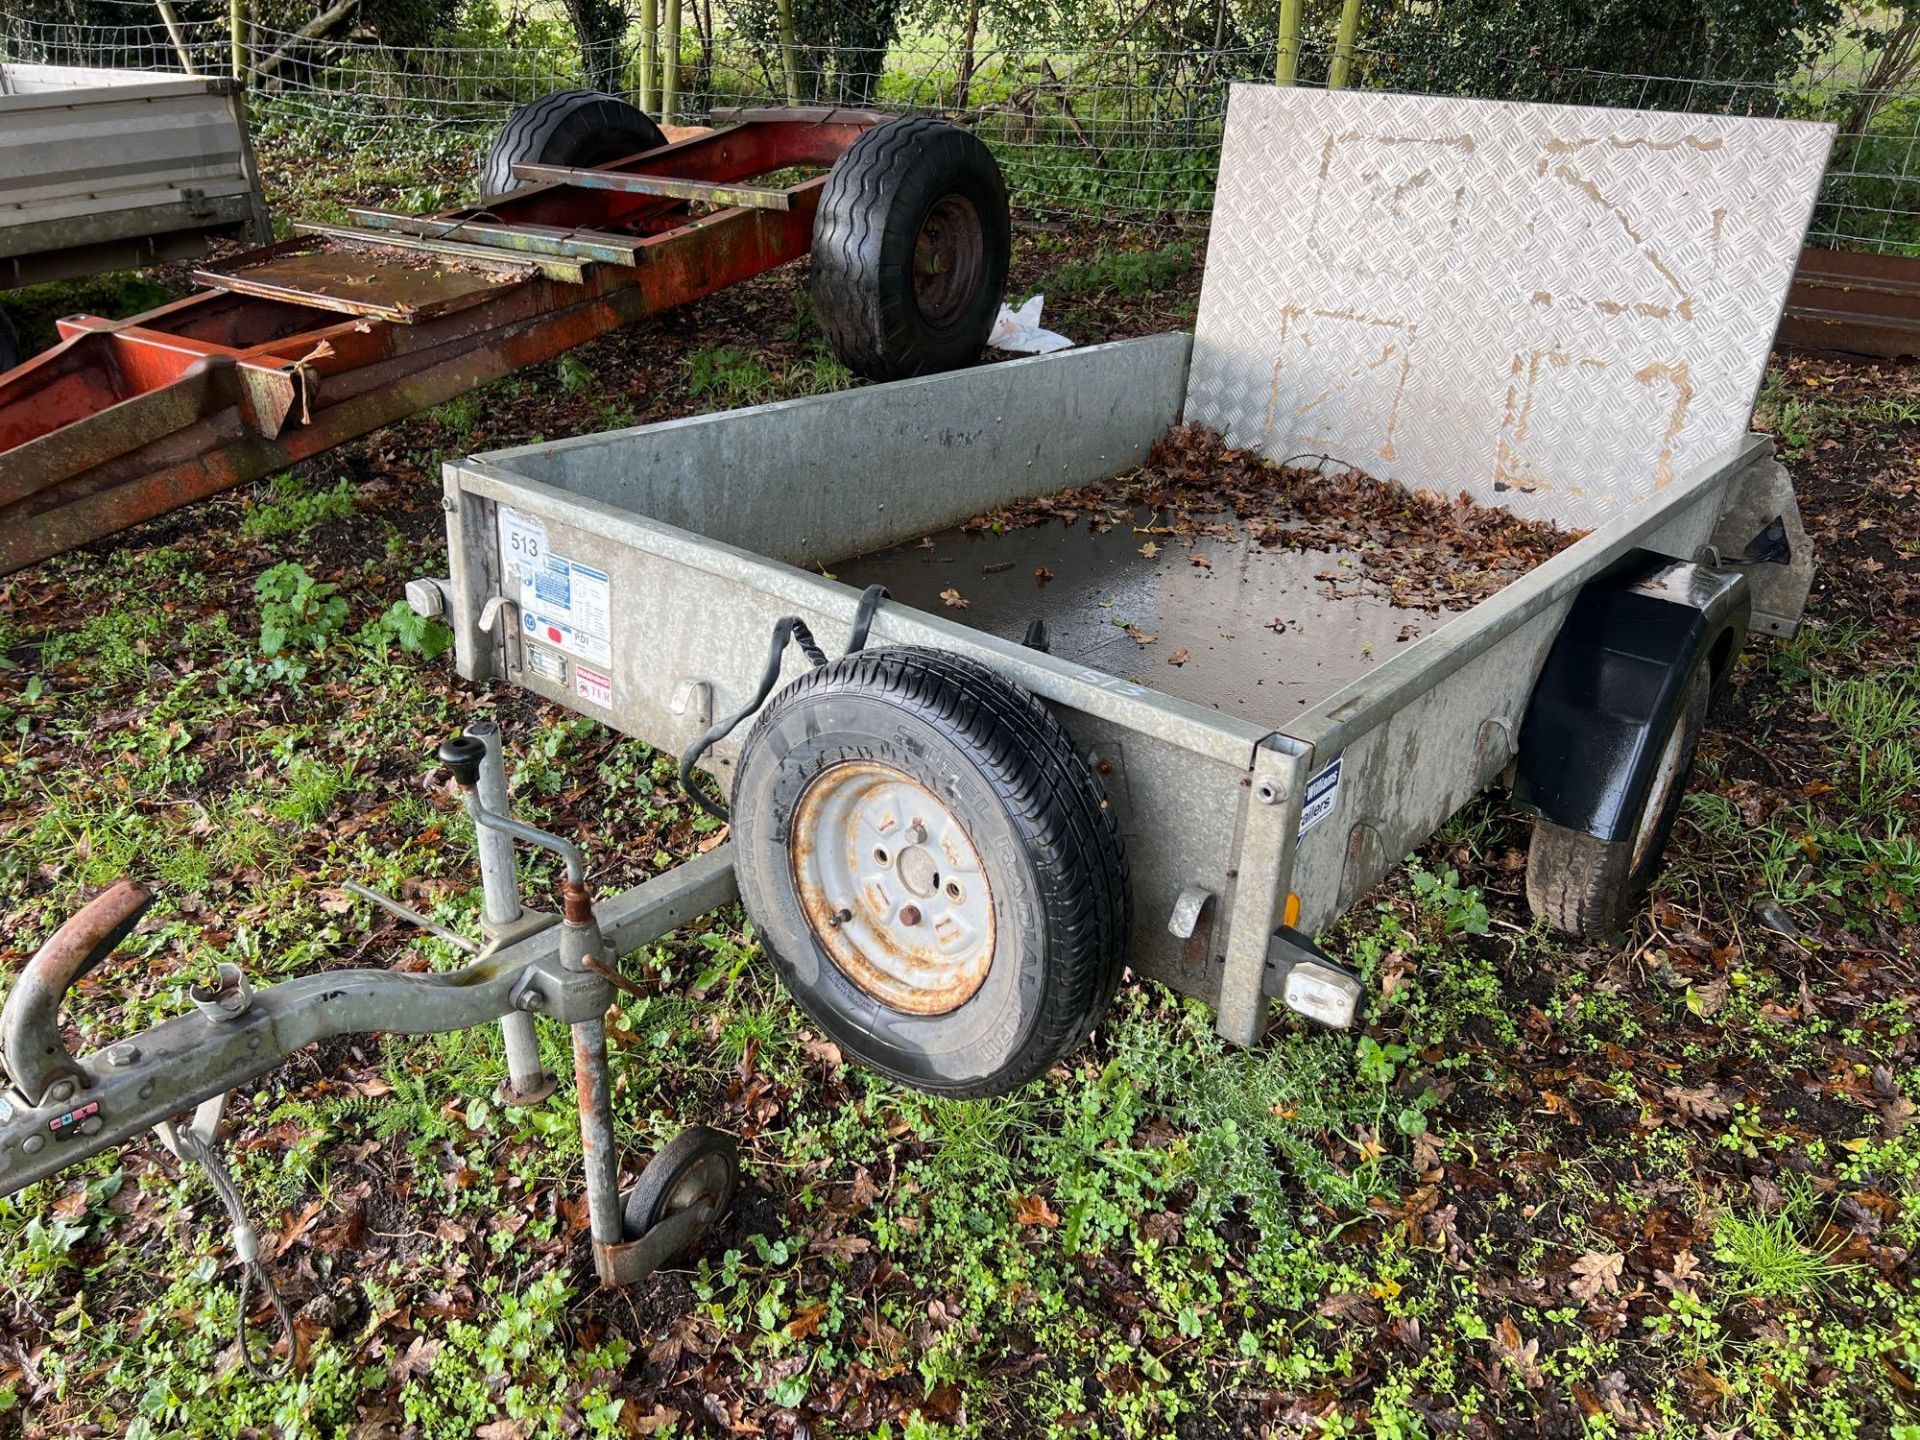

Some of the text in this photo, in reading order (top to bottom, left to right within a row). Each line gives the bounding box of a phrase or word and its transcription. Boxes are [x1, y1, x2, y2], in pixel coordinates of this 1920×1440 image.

[511, 532, 538, 557] 513
[1300, 796, 1331, 826] ailers
[995, 834, 1037, 988] RADIAL
